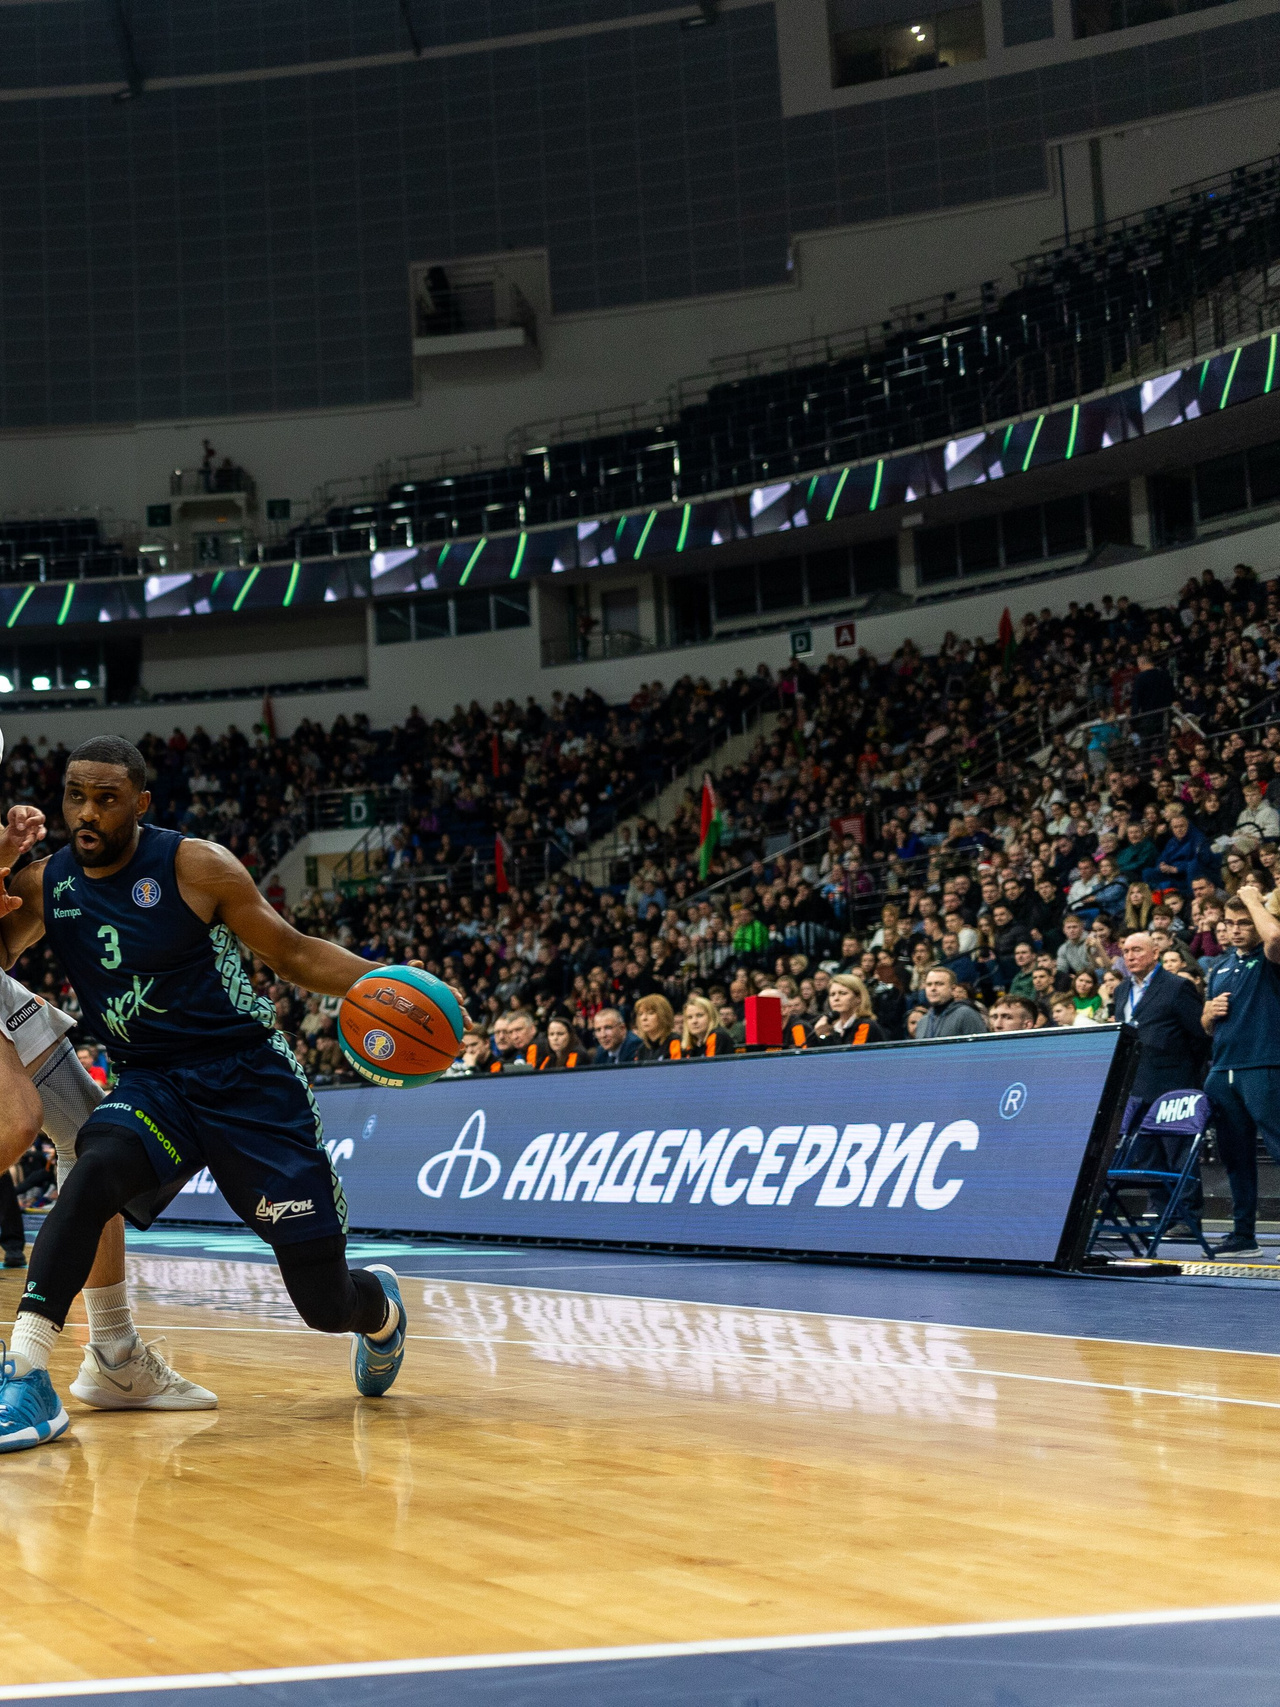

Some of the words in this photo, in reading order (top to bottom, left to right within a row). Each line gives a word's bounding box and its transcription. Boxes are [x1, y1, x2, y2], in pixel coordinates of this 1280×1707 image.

[351, 802, 367, 822] D
[53, 908, 82, 919] Kempa
[97, 925, 122, 969] 3
[8, 1003, 38, 1029] Winline
[135, 1109, 182, 1165] евроопт
[502, 1119, 980, 1211] АКАДЕМСЕРВИС
